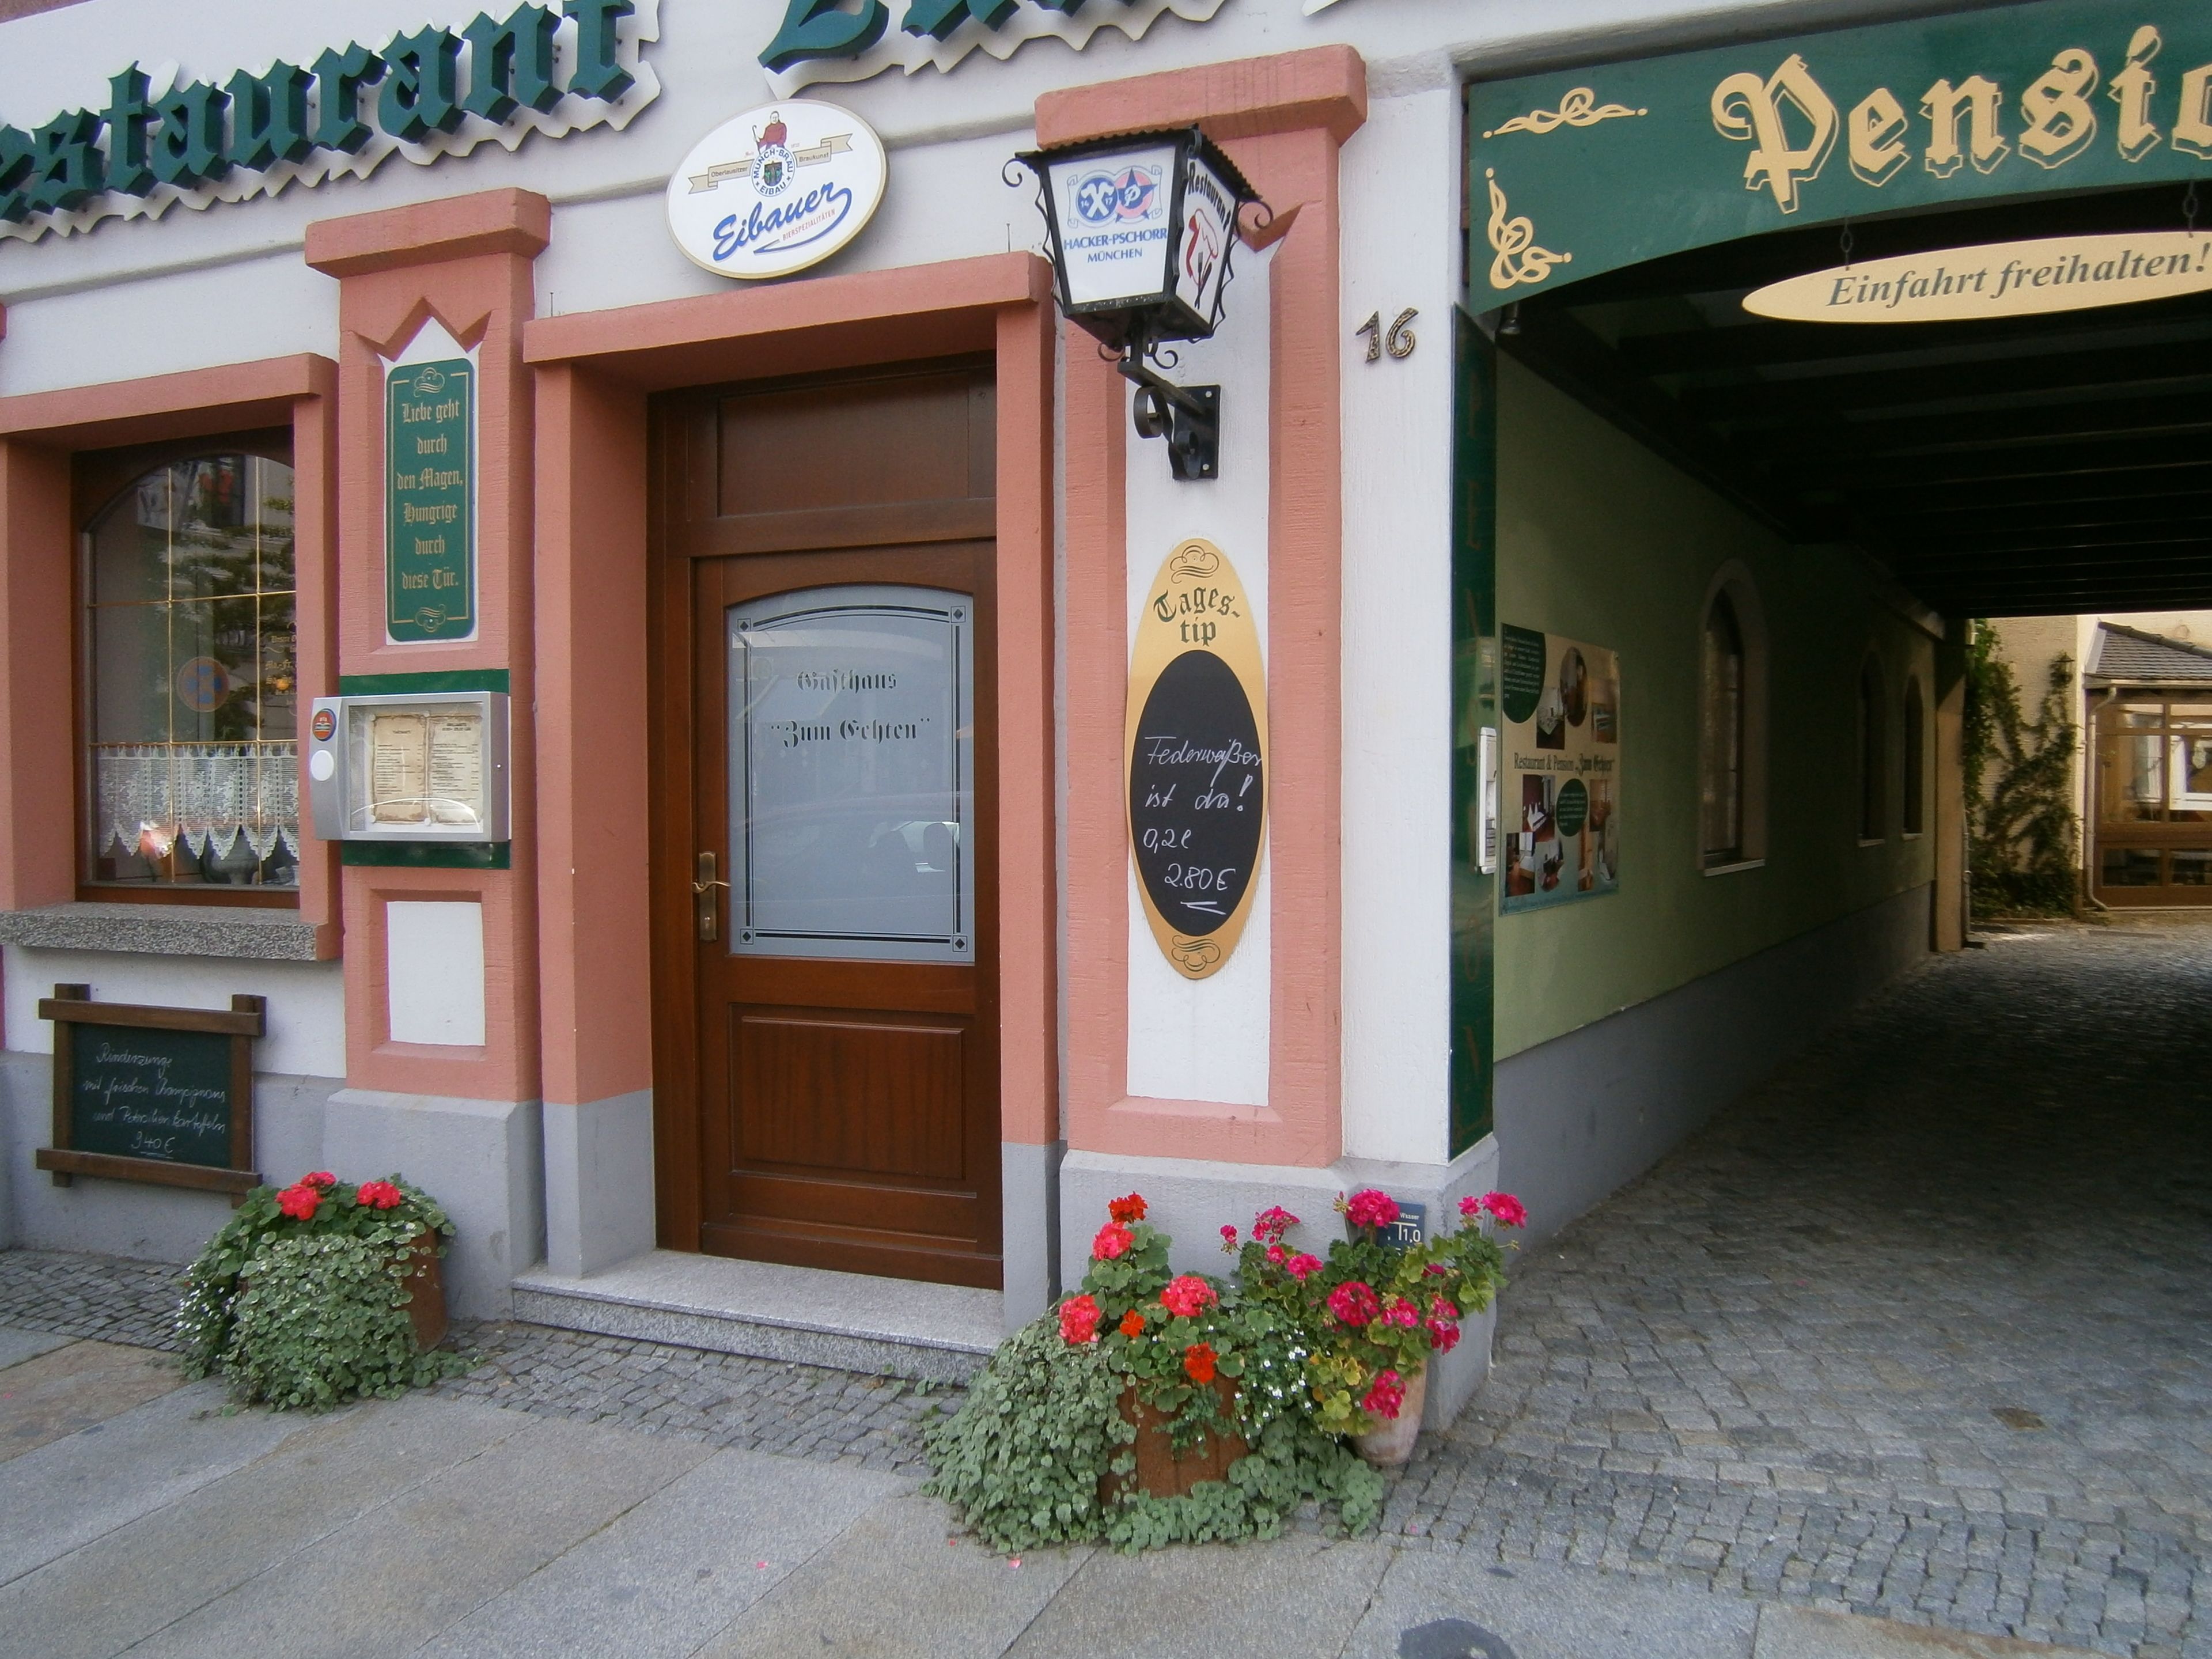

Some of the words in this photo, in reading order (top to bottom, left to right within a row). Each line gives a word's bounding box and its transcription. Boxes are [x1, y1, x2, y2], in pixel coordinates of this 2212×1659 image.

[799, 151, 830, 162] Braukunst
[759, 181, 787, 196] EIBAU
[1187, 161, 1232, 233] Restaurant
[713, 181, 853, 262] Eibauer
[782, 209, 836, 242] BIERSPEZIALITÄTEN
[1063, 227, 1168, 251] HACKER-PSCHORR
[1087, 247, 1143, 263] MÜNCHEN
[1825, 268, 1988, 309] Einfahrt
[1990, 241, 2211, 300] freihalten!
[1355, 307, 1419, 364] 16
[402, 402, 432, 423] Liebe
[436, 398, 460, 423] geht
[416, 433, 448, 456] durch
[397, 472, 415, 490] den
[403, 500, 458, 527] Hungrige
[415, 535, 445, 557] durch
[402, 571, 429, 590] diese
[433, 566, 459, 590] Tür.
[1153, 586, 1241, 623] Tages-
[1180, 616, 1217, 646] tip
[1145, 783, 1177, 807] ist
[82, 1075, 103, 1091] mit
